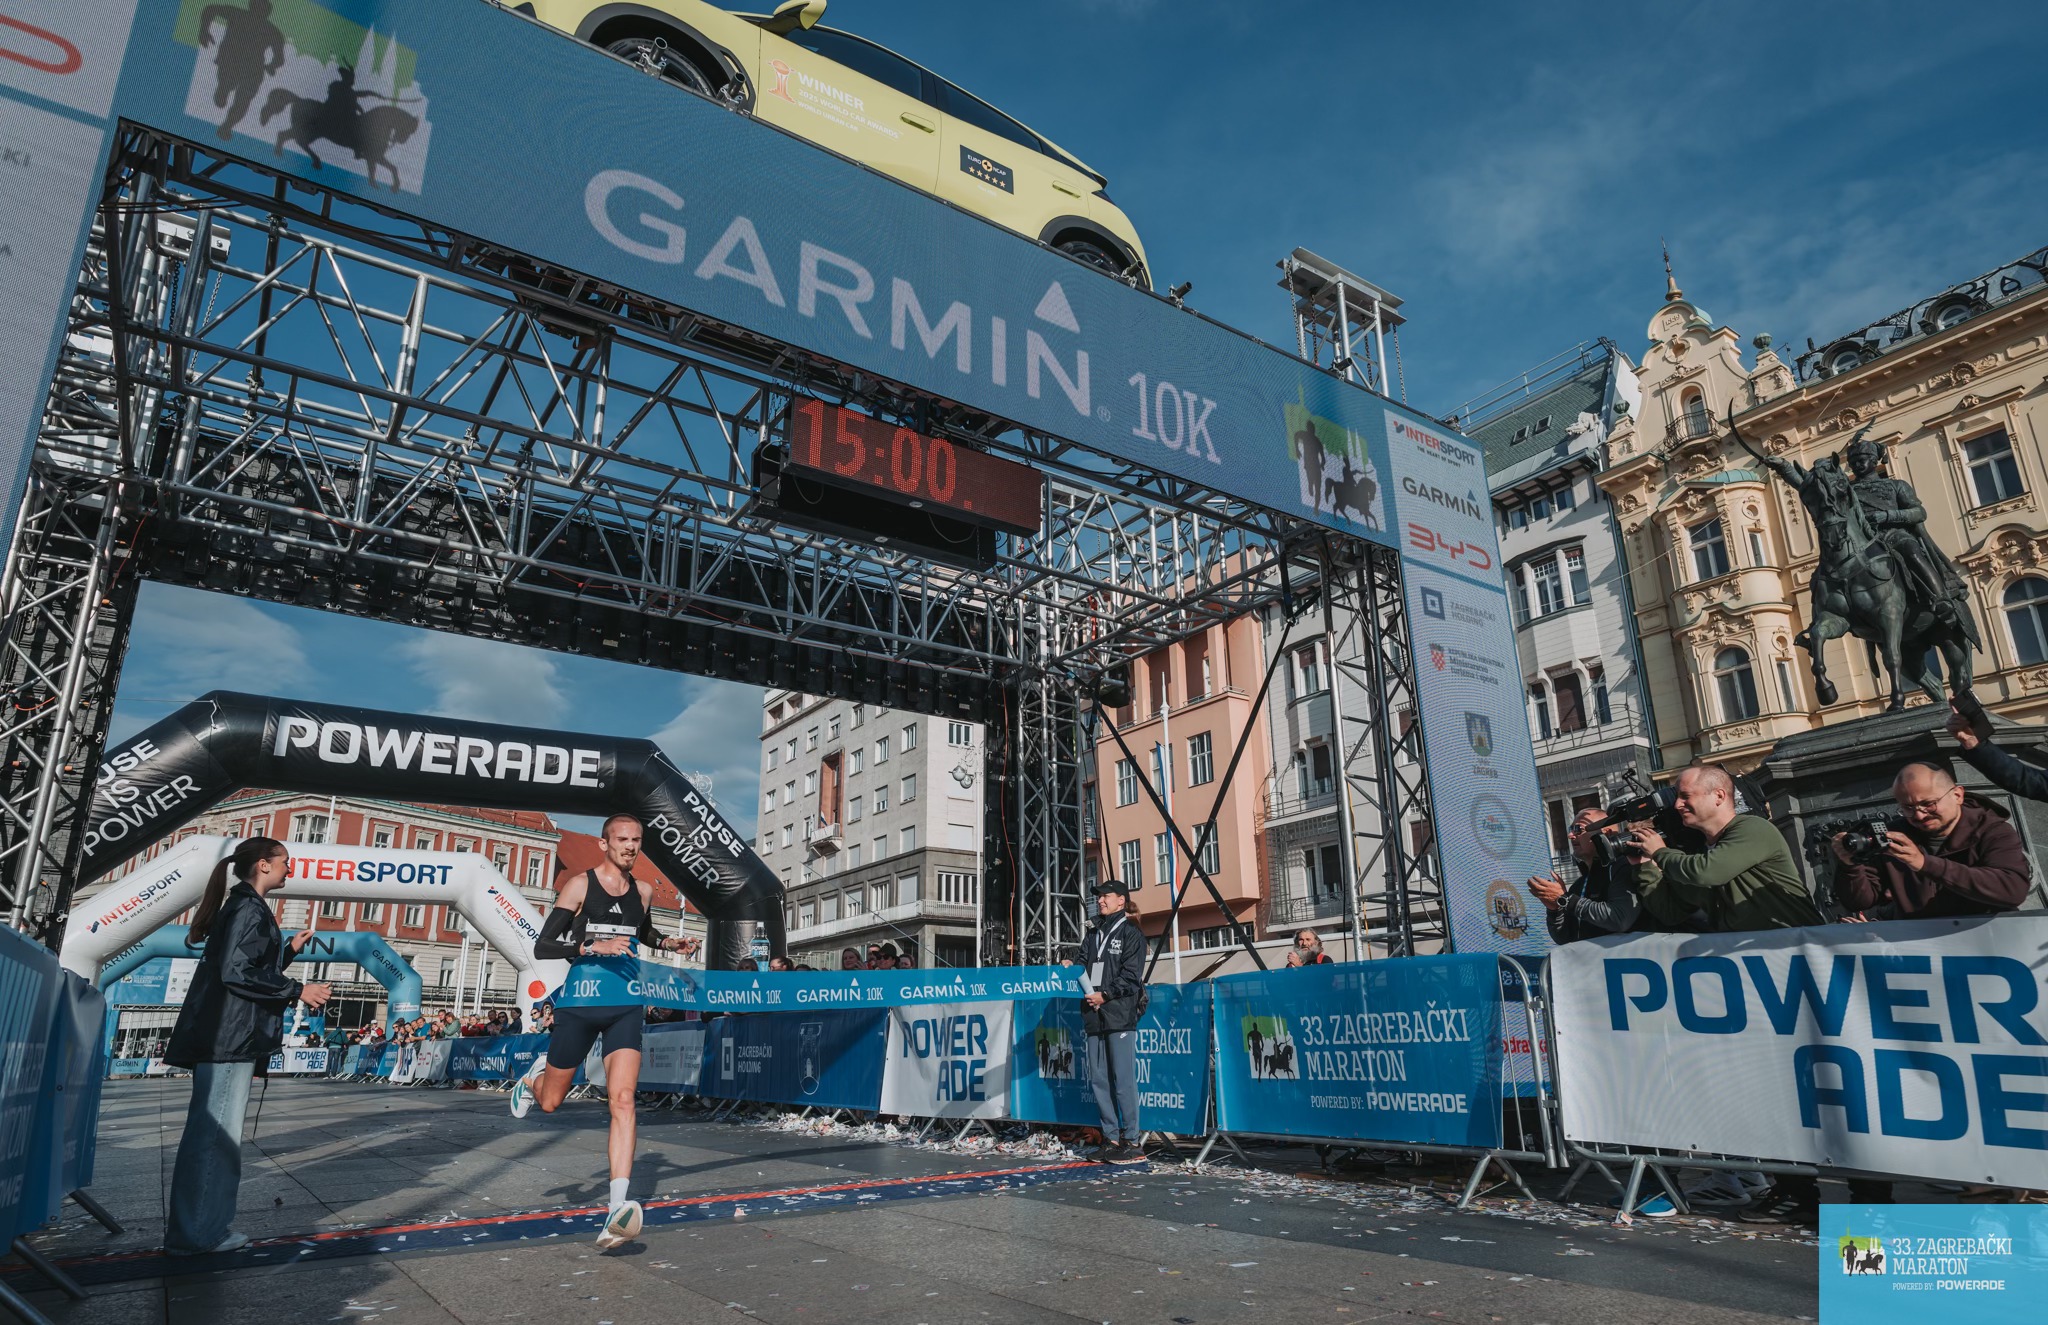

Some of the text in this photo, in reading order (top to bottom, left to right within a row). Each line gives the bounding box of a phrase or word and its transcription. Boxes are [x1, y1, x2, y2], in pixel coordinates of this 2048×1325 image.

[797, 71, 865, 112] WINNER
[798, 102, 822, 116] WORLD
[799, 89, 899, 139] 2025 WORLD CAR AWARDS
[967, 154, 1007, 176] EURO NCAP
[584, 169, 1222, 465] GARMIN 10K
[1405, 425, 1475, 466] INTERSPORT
[1402, 476, 1481, 521] GARMIN
[1408, 522, 1491, 571] BYD
[98, 738, 161, 786] USE
[273, 715, 601, 788] POWERADE
[101, 778, 141, 810] IS
[82, 774, 202, 857] POWER
[682, 790, 745, 858] PAUSE
[647, 813, 720, 890] POWER
[688, 823, 713, 849] IS
[287, 857, 454, 886] TERSPORT
[99, 868, 183, 927] INTERSPORT
[130, 907, 146, 920] HEART
[154, 891, 171, 905] SPORT
[371, 949, 406, 982] GARMIN
[572, 979, 602, 998] 10K
[627, 979, 680, 1002] GARMIN
[707, 989, 782, 1004] GARMIN 10K
[796, 987, 884, 1003] GARMIN 10K
[900, 983, 988, 1000] GARMIN 10K
[1001, 979, 1080, 995] GARMIN 10K
[1602, 955, 2048, 1046] POWER
[901, 1014, 989, 1058] POWER
[1300, 1000, 1471, 1046] 33. ZAGREBAČKI
[295, 1051, 327, 1060] POWER
[306, 1060, 325, 1069] ADE
[738, 1044, 773, 1058] ZAGREBAČKI
[1305, 1050, 1407, 1082] MARATON
[936, 1059, 987, 1102] ADE
[1137, 1093, 1186, 1109] WERADE
[1310, 1091, 1468, 1114] POWERED BY: POWERADE
[1793, 1044, 2048, 1150] ADE
